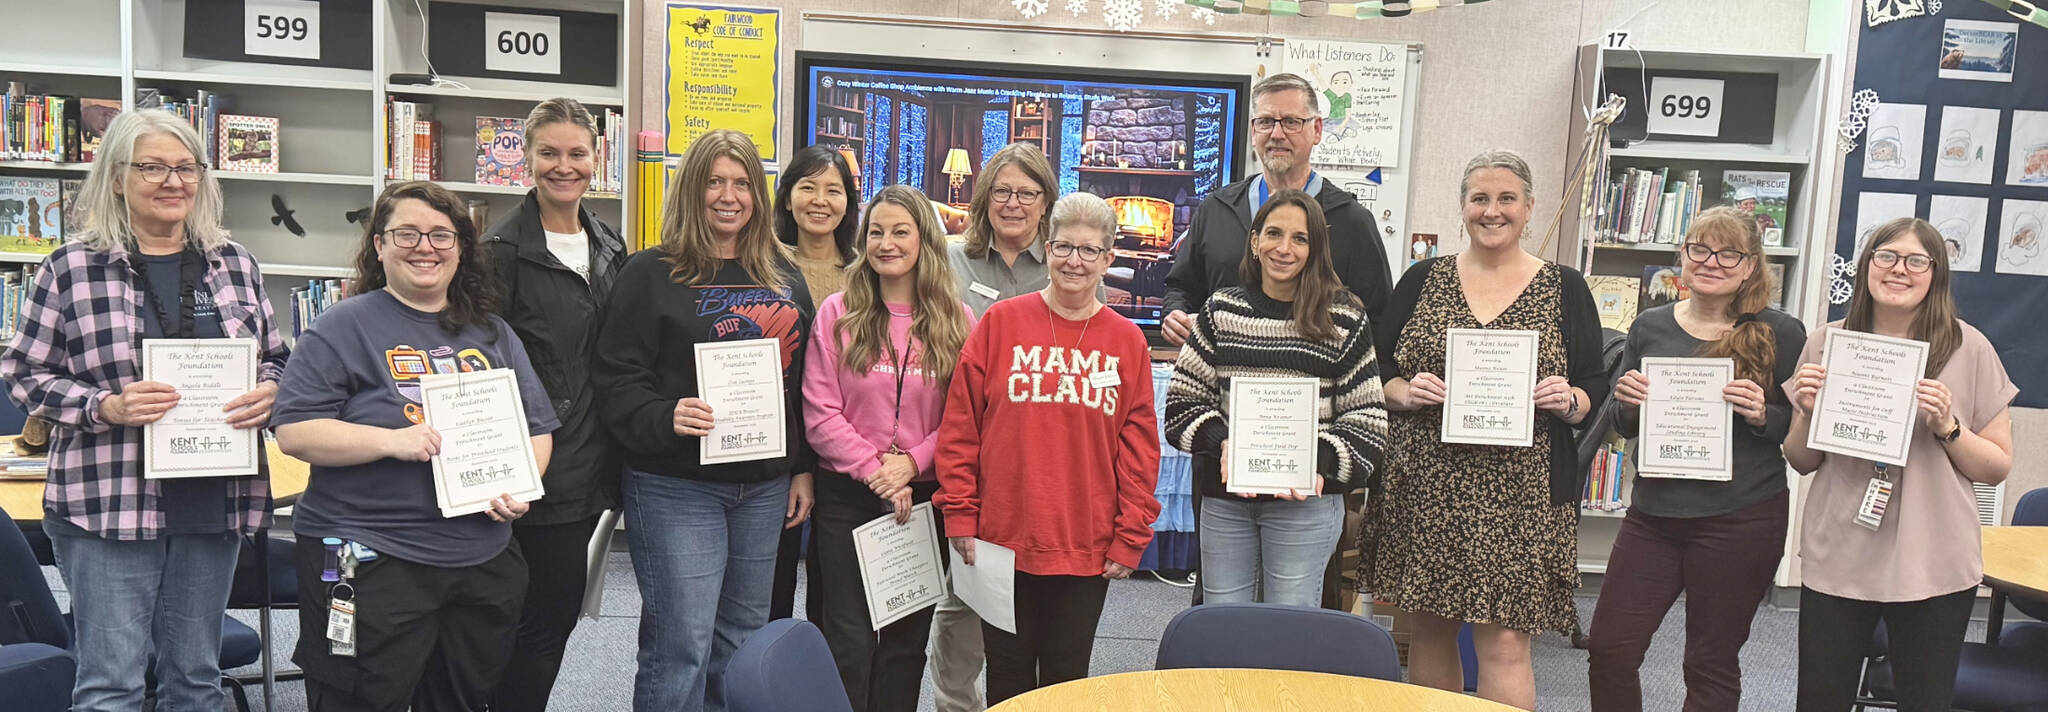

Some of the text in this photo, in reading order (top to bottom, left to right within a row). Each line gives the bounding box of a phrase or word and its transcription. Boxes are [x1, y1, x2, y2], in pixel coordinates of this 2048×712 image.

[724, 14, 752, 24] FAIRWOOD
[256, 14, 308, 42] 599
[713, 26, 763, 37] CODE OF CONDUCT
[496, 30, 550, 56] 600
[685, 37, 714, 49] Respect
[1607, 32, 1627, 47] 17
[1288, 43, 1322, 60] What
[1325, 41, 1372, 62] Listeners
[684, 81, 737, 96] Responsibility
[1026, 91, 1051, 99] Fireplace
[1660, 94, 1711, 119] 699
[684, 115, 710, 129] Safety
[493, 136, 523, 149] POP!
[1318, 144, 1350, 155] Students
[1728, 174, 1746, 182] RATS
[1757, 179, 1786, 188] RESCUE
[714, 318, 740, 337] BUF
[1861, 345, 1879, 354] Kent
[1882, 349, 1906, 358] Schools
[722, 361, 757, 370] Foundation
[1011, 345, 1120, 375] MAMA
[1854, 353, 1896, 365] Foundation
[441, 392, 452, 401] The
[473, 386, 499, 396] Schools
[1008, 372, 1118, 416] CLAUS
[451, 397, 492, 409] Foundation
[1834, 422, 1858, 433] KENT
[170, 437, 197, 447] KENT
[721, 433, 742, 443] KENT
[1660, 445, 1682, 453] KENT
[460, 468, 484, 481] KENT
[886, 593, 905, 606] KENT
